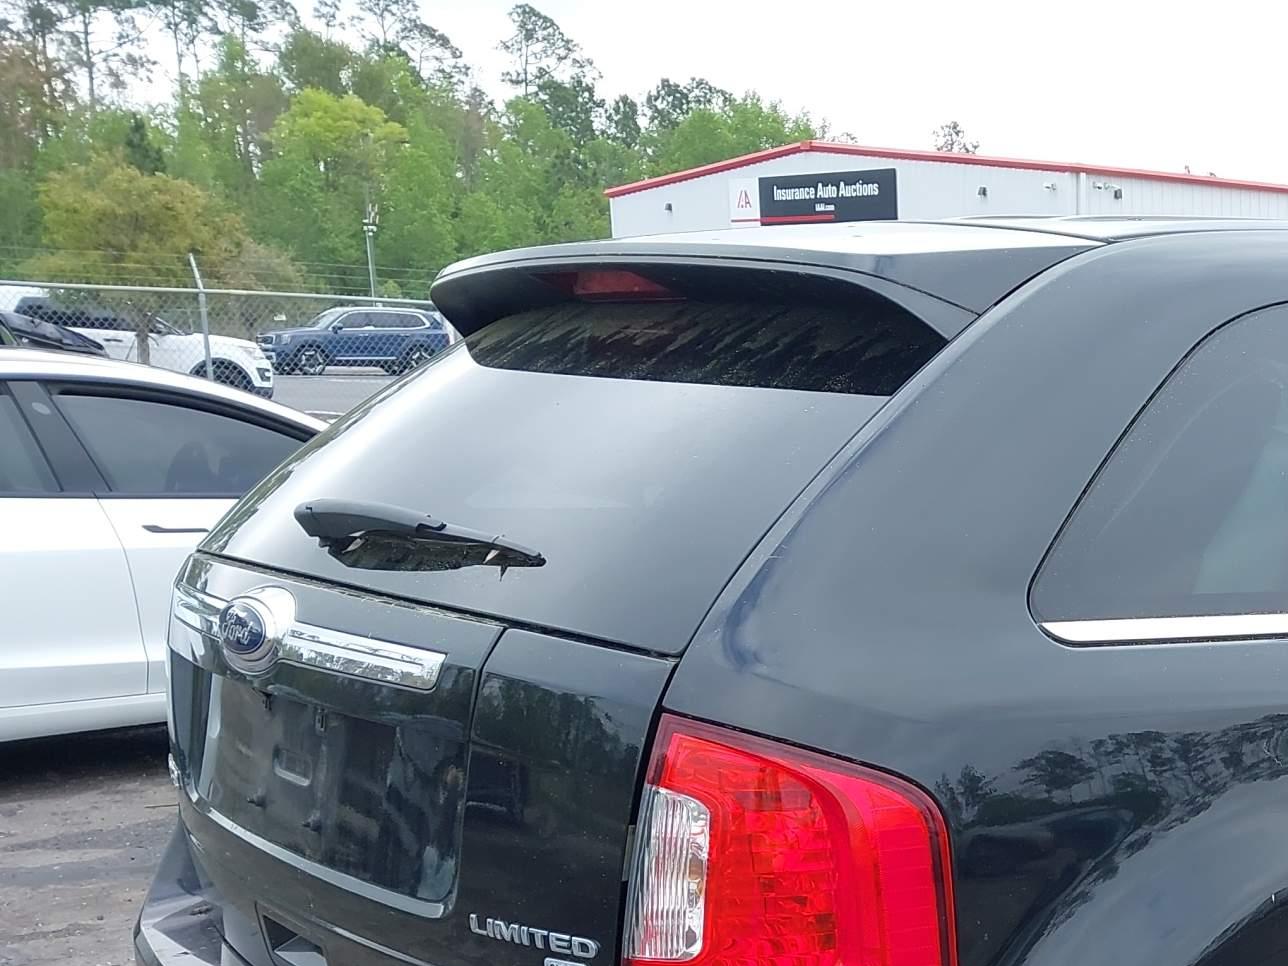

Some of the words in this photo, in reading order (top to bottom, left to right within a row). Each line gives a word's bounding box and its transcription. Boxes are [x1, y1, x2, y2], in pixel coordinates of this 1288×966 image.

[773, 184, 816, 201] Insurance
[816, 182, 838, 199] Auto
[838, 179, 880, 198] Auctions
[222, 609, 255, 645] Ford
[469, 913, 600, 959] LIMITED
